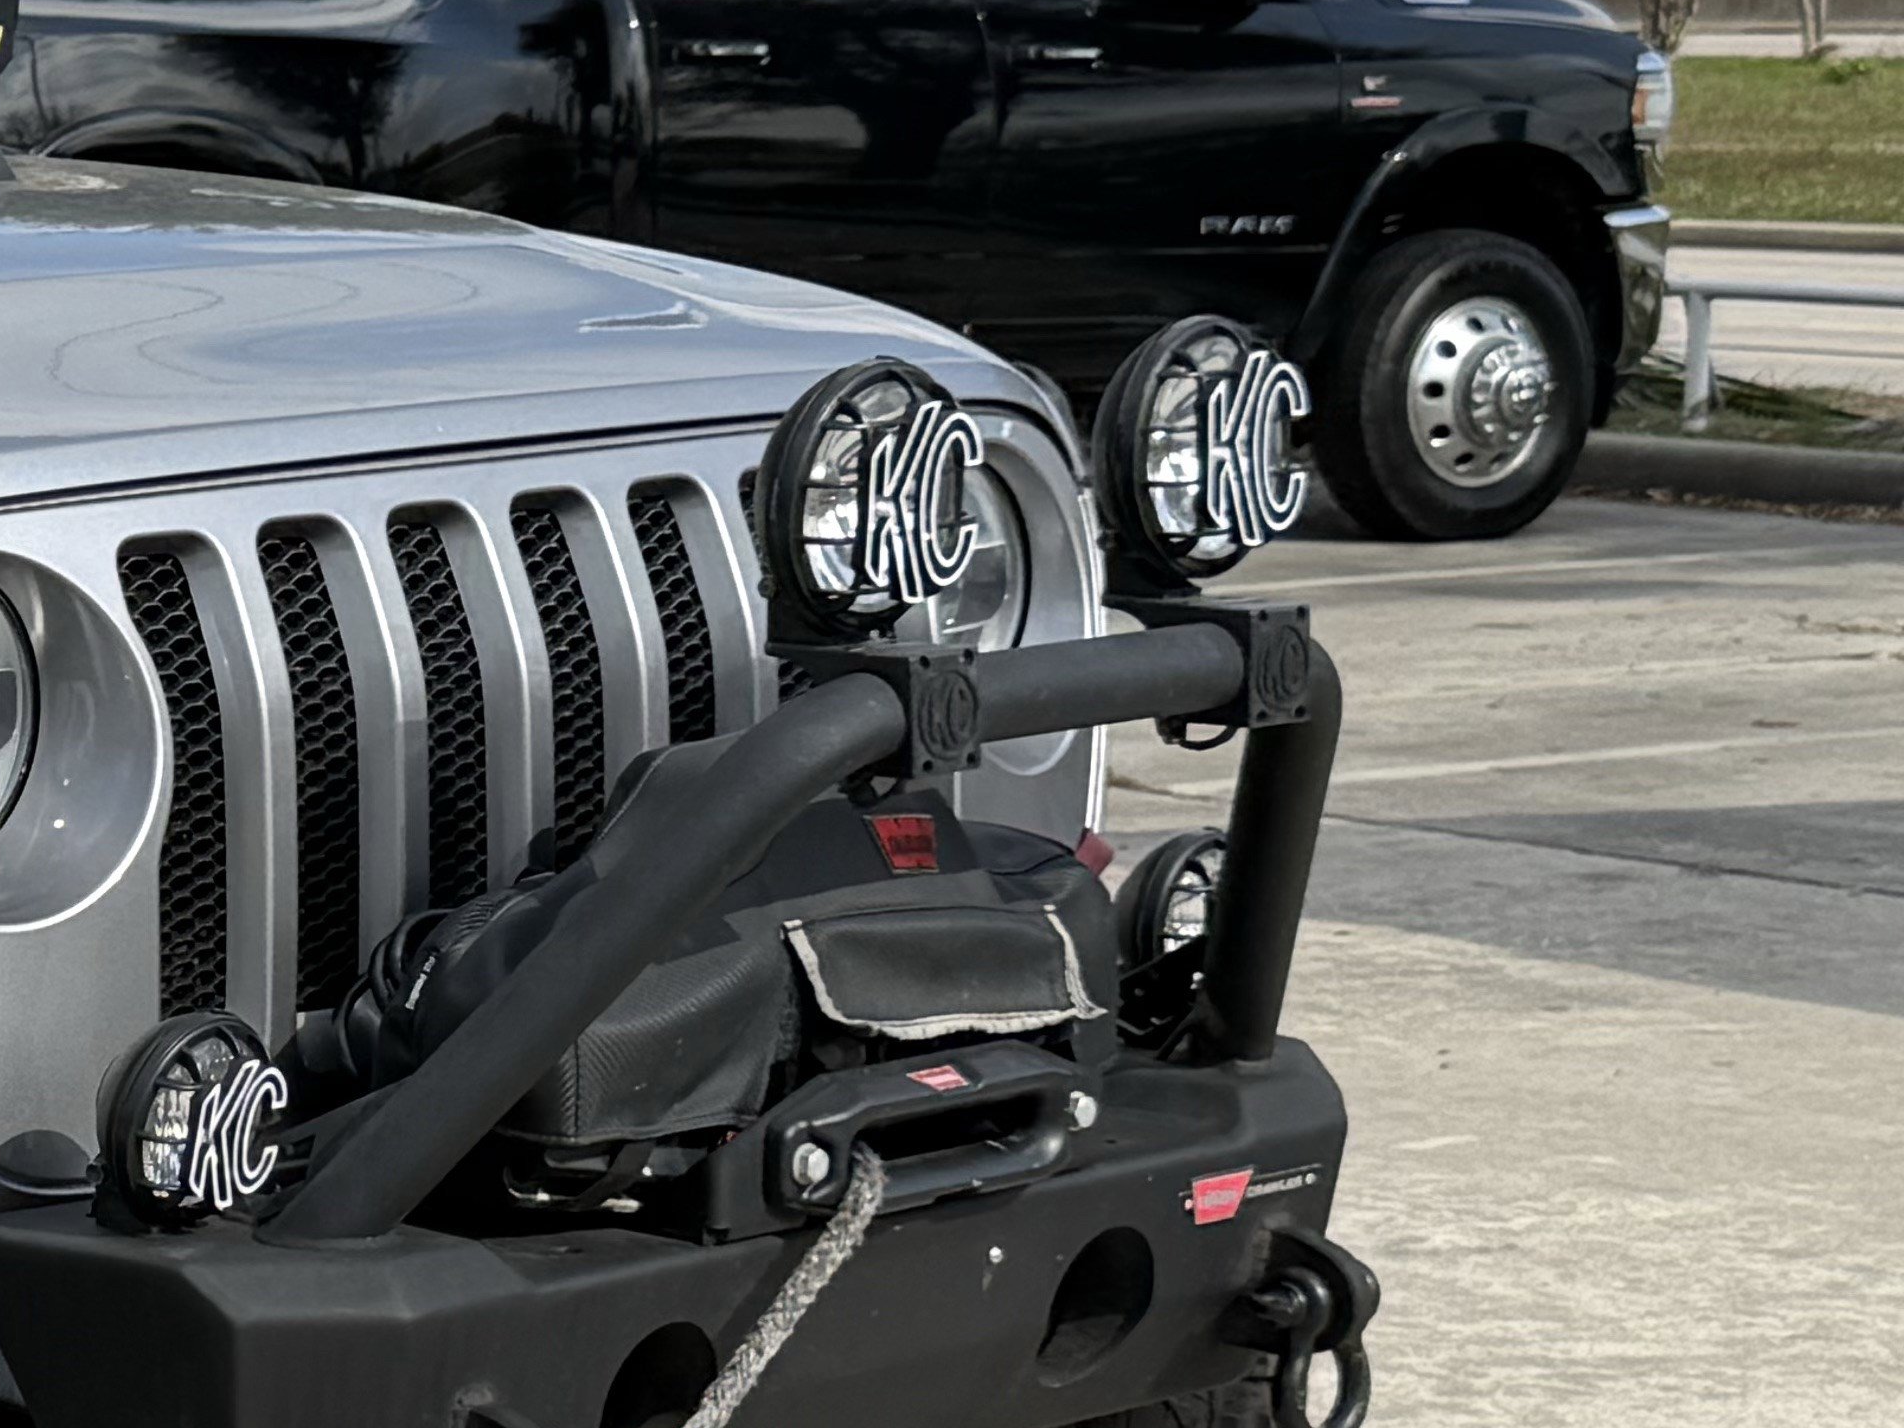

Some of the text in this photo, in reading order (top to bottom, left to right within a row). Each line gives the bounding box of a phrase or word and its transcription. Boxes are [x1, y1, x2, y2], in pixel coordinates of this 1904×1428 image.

[864, 399, 984, 605] KC
[1206, 350, 1310, 547] KC
[189, 1059, 288, 1211] KC
